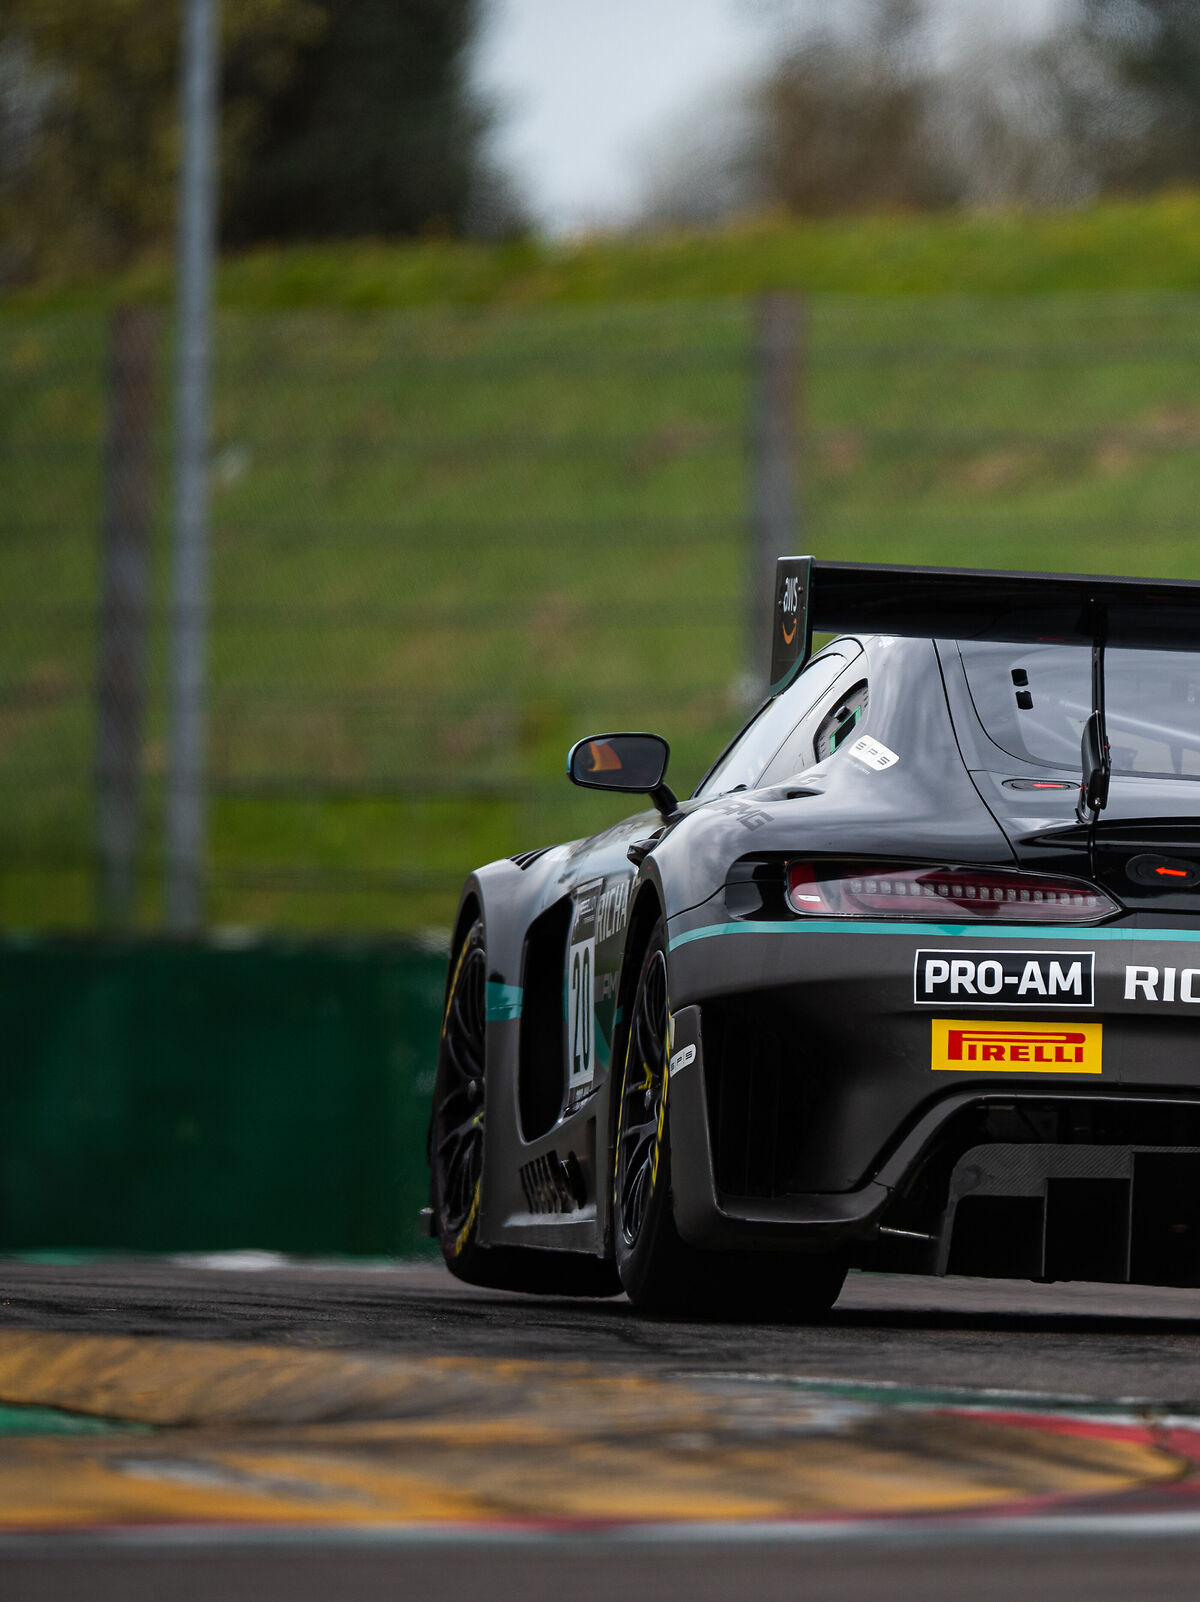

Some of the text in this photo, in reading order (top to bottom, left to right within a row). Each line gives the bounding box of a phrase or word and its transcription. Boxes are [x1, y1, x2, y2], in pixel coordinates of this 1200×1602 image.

[783, 577, 797, 613] aws
[924, 959, 1082, 996] PRO-AM
[572, 946, 590, 1075] 20
[947, 1029, 1086, 1063] PIRELLI
